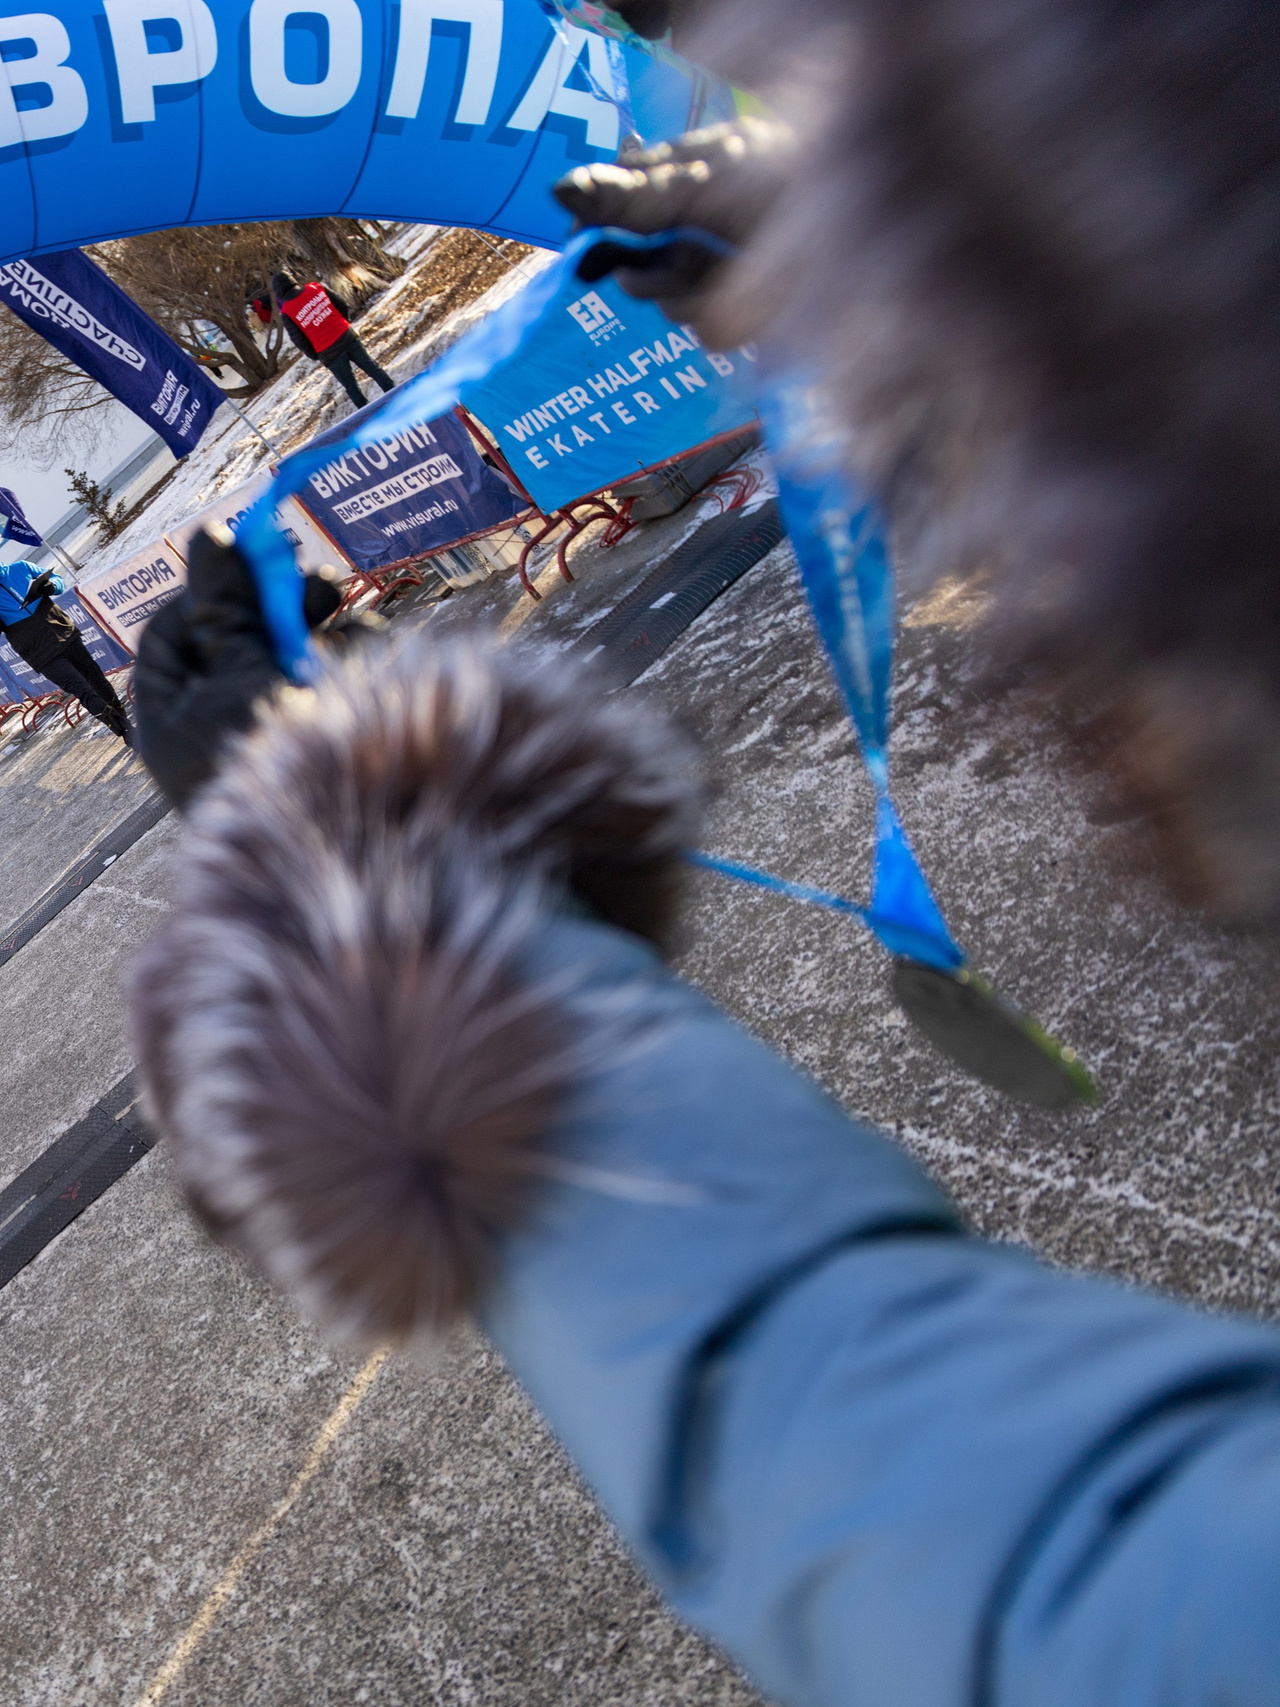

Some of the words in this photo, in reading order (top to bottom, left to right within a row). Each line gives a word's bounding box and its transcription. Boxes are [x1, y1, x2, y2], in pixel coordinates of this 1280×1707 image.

[9, 261, 144, 366] СЧАСТЛИВ
[589, 318, 621, 342] EUROPE
[504, 385, 594, 443] WINTER
[586, 324, 703, 398] HALFMAR
[525, 343, 753, 470] EKATERINB
[308, 419, 438, 499] ВИКТОРИЯ
[381, 498, 460, 538] www.visural.ru
[97, 557, 176, 611] ВИКТОРИЯ
